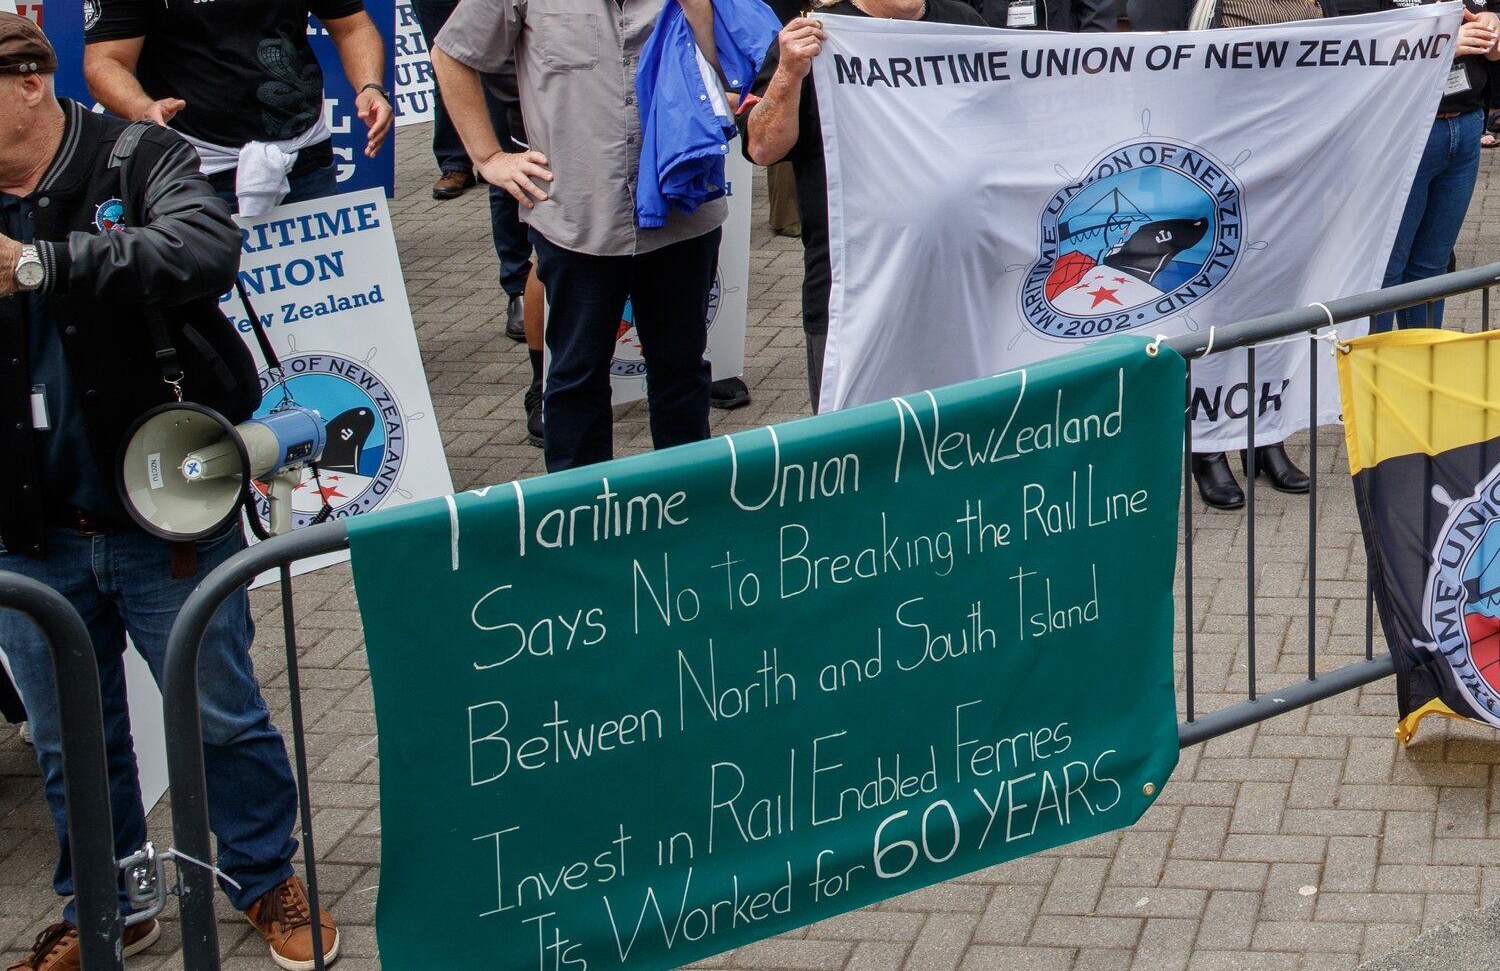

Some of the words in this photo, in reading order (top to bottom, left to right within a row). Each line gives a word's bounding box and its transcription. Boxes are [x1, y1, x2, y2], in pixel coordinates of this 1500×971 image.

[834, 49, 1011, 89] MARITIME
[1021, 44, 1135, 80] UNION
[1144, 43, 1189, 71] OF
[1204, 39, 1290, 70] NEW
[1296, 32, 1453, 68] ZEALAND
[1138, 145, 1177, 166] OF
[1180, 151, 1239, 206] NEW
[280, 284, 385, 326] Zealand
[1025, 225, 1058, 331] MARITIME
[1155, 202, 1240, 316] ZEALAND
[1062, 313, 1132, 336] 2002
[291, 357, 323, 373] OF
[329, 357, 379, 390] NEW
[371, 395, 403, 497] ZEALAND
[442, 477, 690, 572] Maritime
[724, 425, 860, 511] Union
[471, 584, 606, 670] Says
[633, 552, 700, 635] No
[779, 511, 954, 599] Breaking
[956, 499, 1011, 555] the
[1023, 470, 1076, 541] Rail
[1087, 463, 1149, 527] Line
[468, 700, 663, 787] Between
[677, 638, 796, 731] North
[819, 628, 882, 692] and
[896, 596, 997, 671] South
[1009, 563, 1100, 641] Island
[472, 822, 632, 917] Invest
[658, 831, 694, 867] in
[708, 748, 795, 854] Rail
[812, 730, 938, 826] Enabled
[955, 699, 1073, 783] Ferries
[603, 860, 793, 963] Worked
[808, 849, 865, 903] for
[873, 799, 961, 879] 60
[973, 749, 1121, 850] YEARS
